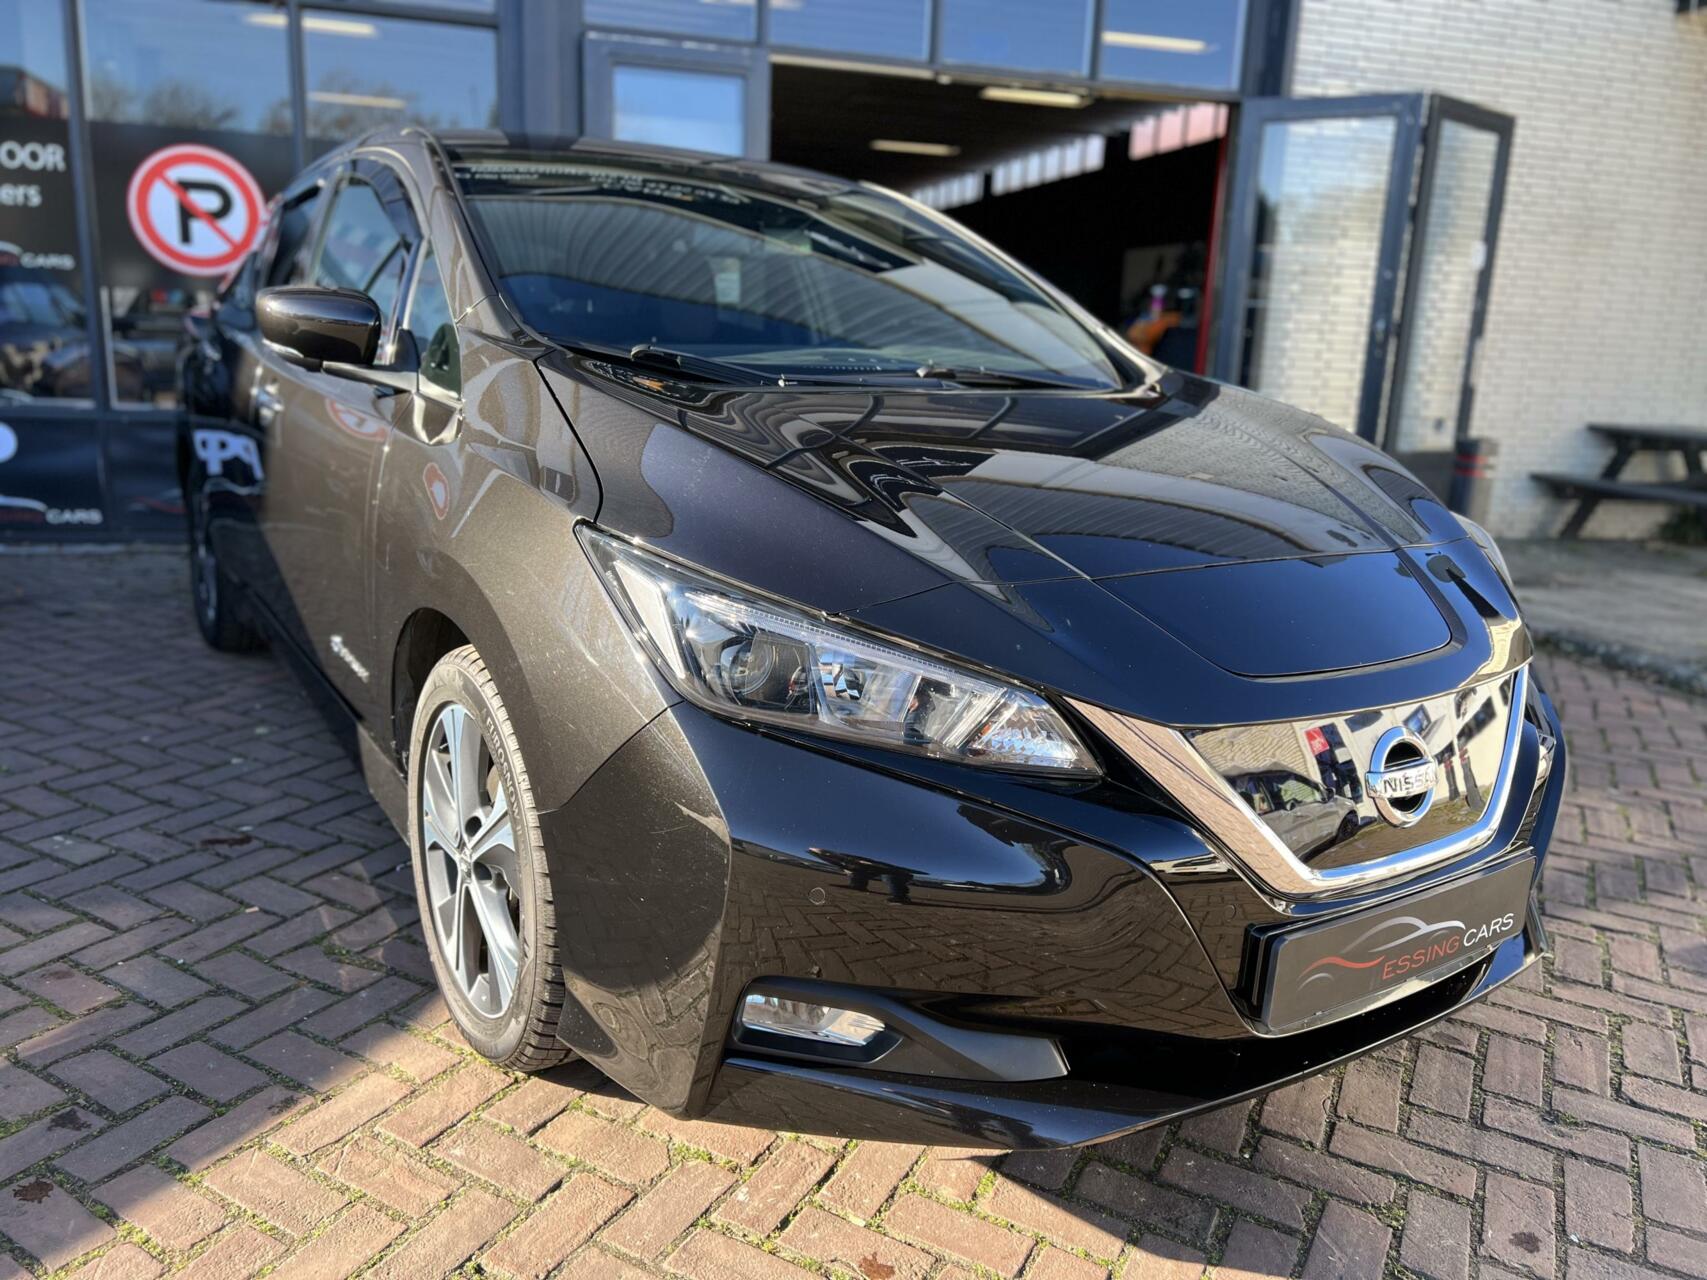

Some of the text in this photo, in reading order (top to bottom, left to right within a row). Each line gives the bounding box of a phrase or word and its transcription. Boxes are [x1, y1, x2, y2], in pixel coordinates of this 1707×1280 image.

[177, 178, 234, 244] P
[45, 508, 103, 525] CARS
[1382, 913, 1515, 980] ESSING CARS
